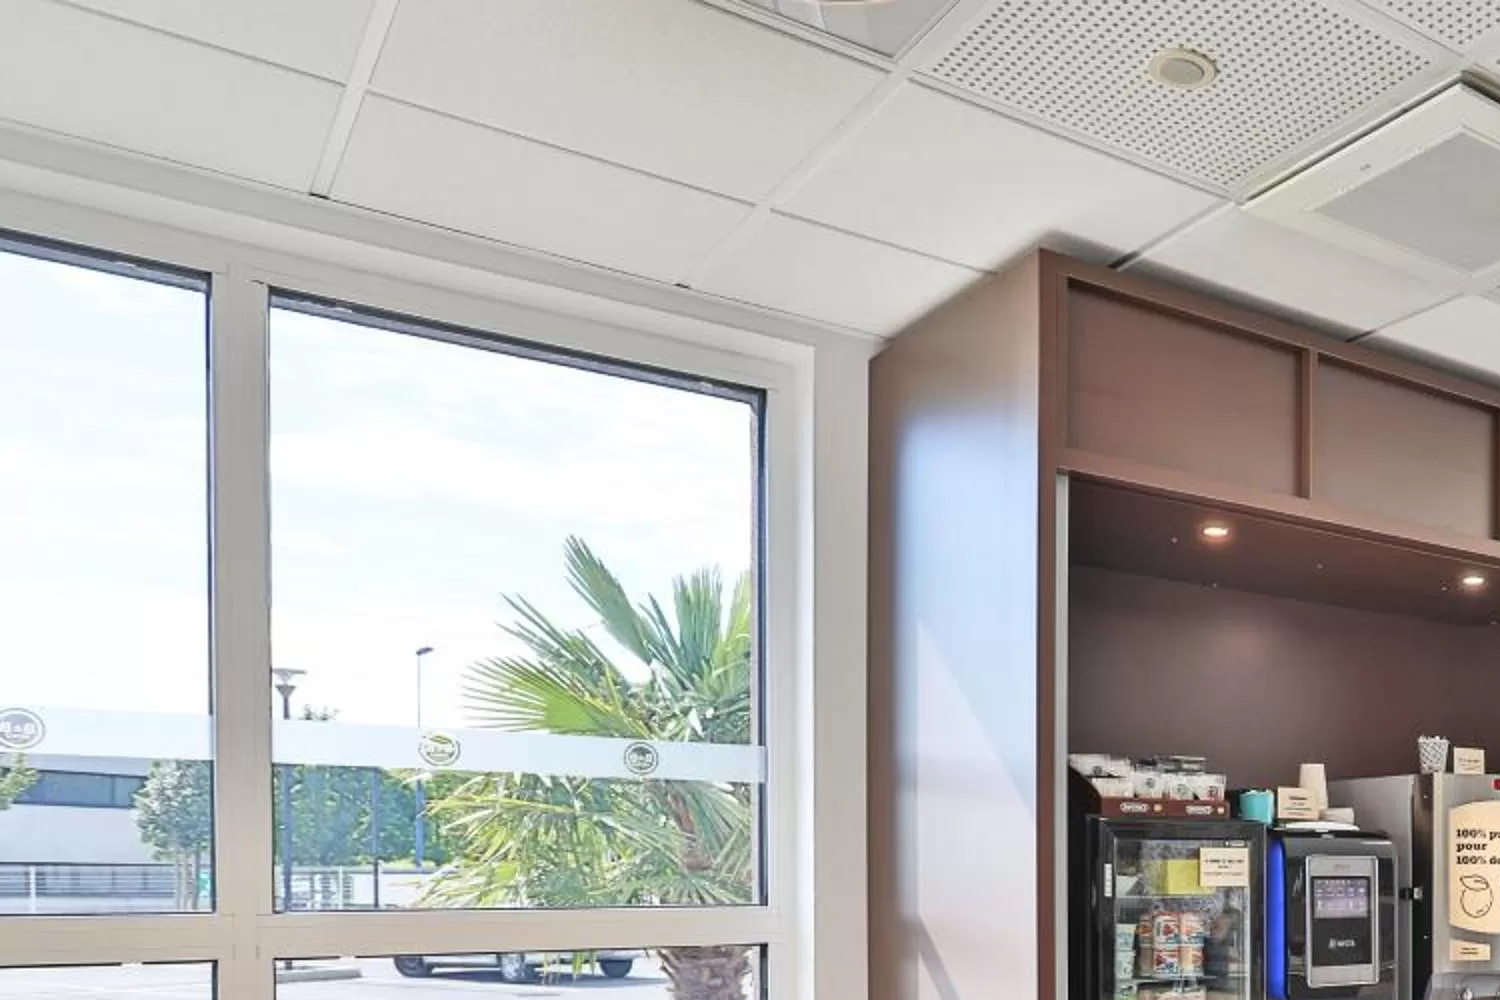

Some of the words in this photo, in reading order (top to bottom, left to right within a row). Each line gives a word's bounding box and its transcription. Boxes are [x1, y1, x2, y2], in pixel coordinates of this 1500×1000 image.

[1456, 828, 1486, 838] 100%
[1456, 843, 1488, 852] pour
[1456, 856, 1486, 864] 100%
